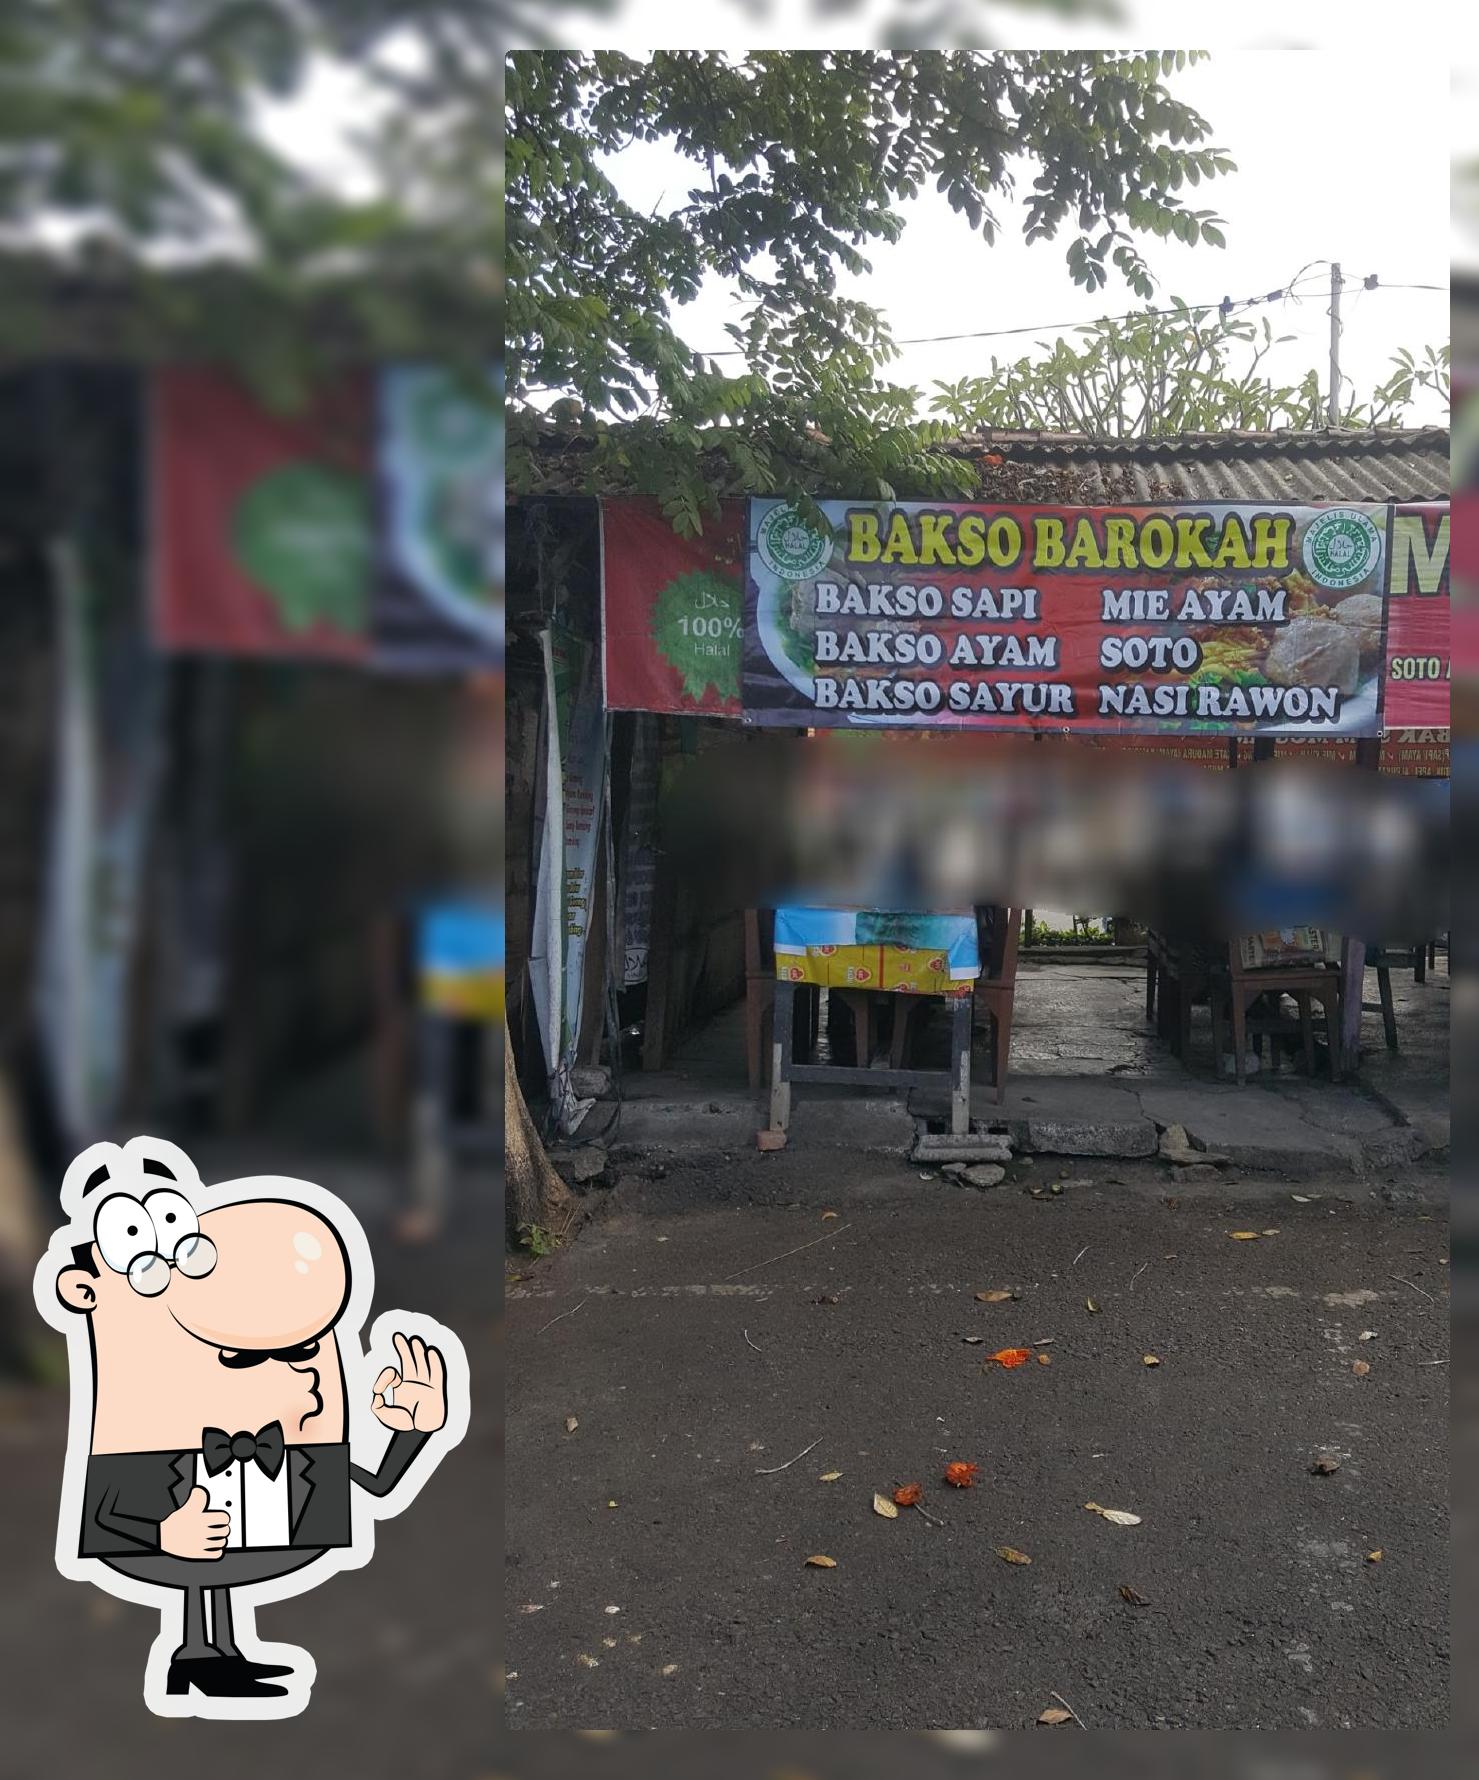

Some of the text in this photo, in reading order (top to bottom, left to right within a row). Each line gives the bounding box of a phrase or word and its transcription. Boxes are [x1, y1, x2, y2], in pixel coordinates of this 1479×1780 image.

[848, 514, 1021, 567] BAKSO
[1033, 517, 1290, 568] BAROKAH
[1330, 550, 1351, 558] HALAL
[1311, 568, 1370, 587] INDONESIA
[816, 583, 1037, 619] BAKSO SAPI
[1102, 590, 1287, 621] MIE AYAM
[678, 616, 744, 638] 100%
[694, 642, 730, 656] Halal
[815, 631, 1057, 667] BAKSO AYAM
[1100, 637, 1198, 668] SOTO
[1391, 657, 1440, 680] SOTO
[814, 678, 1074, 713] BAKSO SAYUR
[1098, 685, 1339, 719] NASI RAWON
